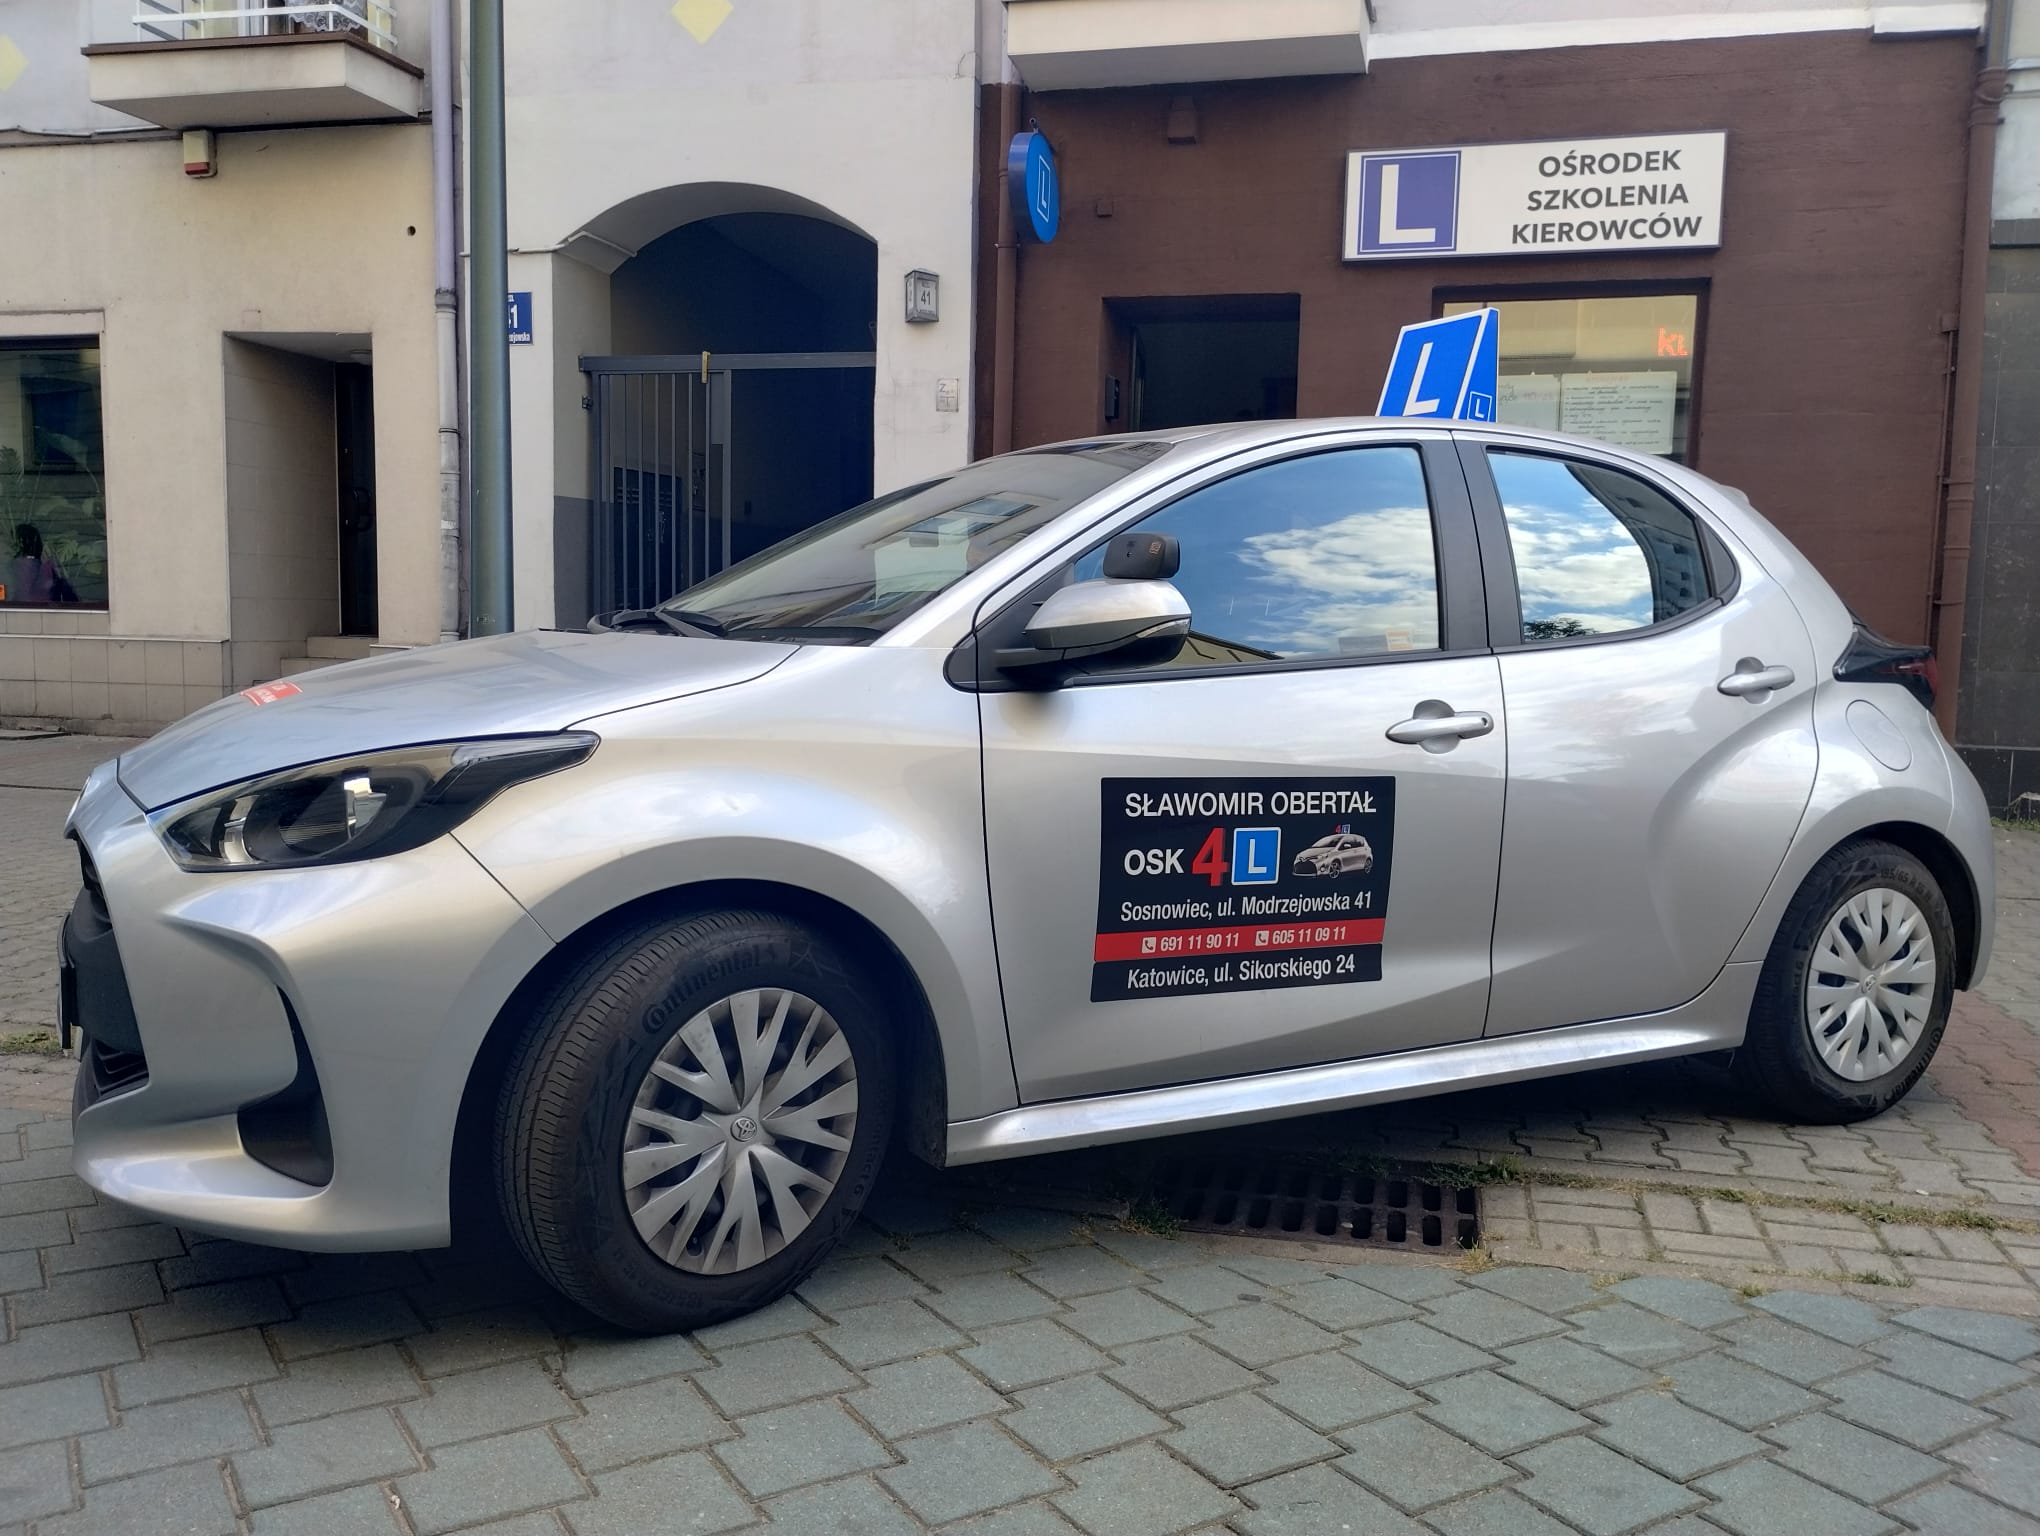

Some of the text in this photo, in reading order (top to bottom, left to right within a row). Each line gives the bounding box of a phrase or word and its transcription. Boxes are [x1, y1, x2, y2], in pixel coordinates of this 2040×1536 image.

[1538, 149, 1683, 178] OŚRODEK
[1379, 163, 1436, 245] L
[1527, 183, 1689, 211] SZKOLENIA
[1512, 213, 1702, 244] KIEROWCÓW
[920, 289, 932, 305] 41
[508, 304, 518, 329] 1
[1402, 341, 1440, 418] L
[1474, 398, 1485, 419] L
[1125, 791, 1377, 817] SŁAWOMIR OBERTAŁ
[1124, 848, 1184, 876] OSK
[1191, 827, 1229, 887] 4
[1120, 890, 1371, 921] Sosnowiec, ul. Modrzejowska 41
[1160, 926, 1347, 951] 691 11 90 11 605 11 09 11
[1127, 953, 1356, 989] Katowice, ul. Sikorskiego 24
[642, 945, 761, 1034] Continental
